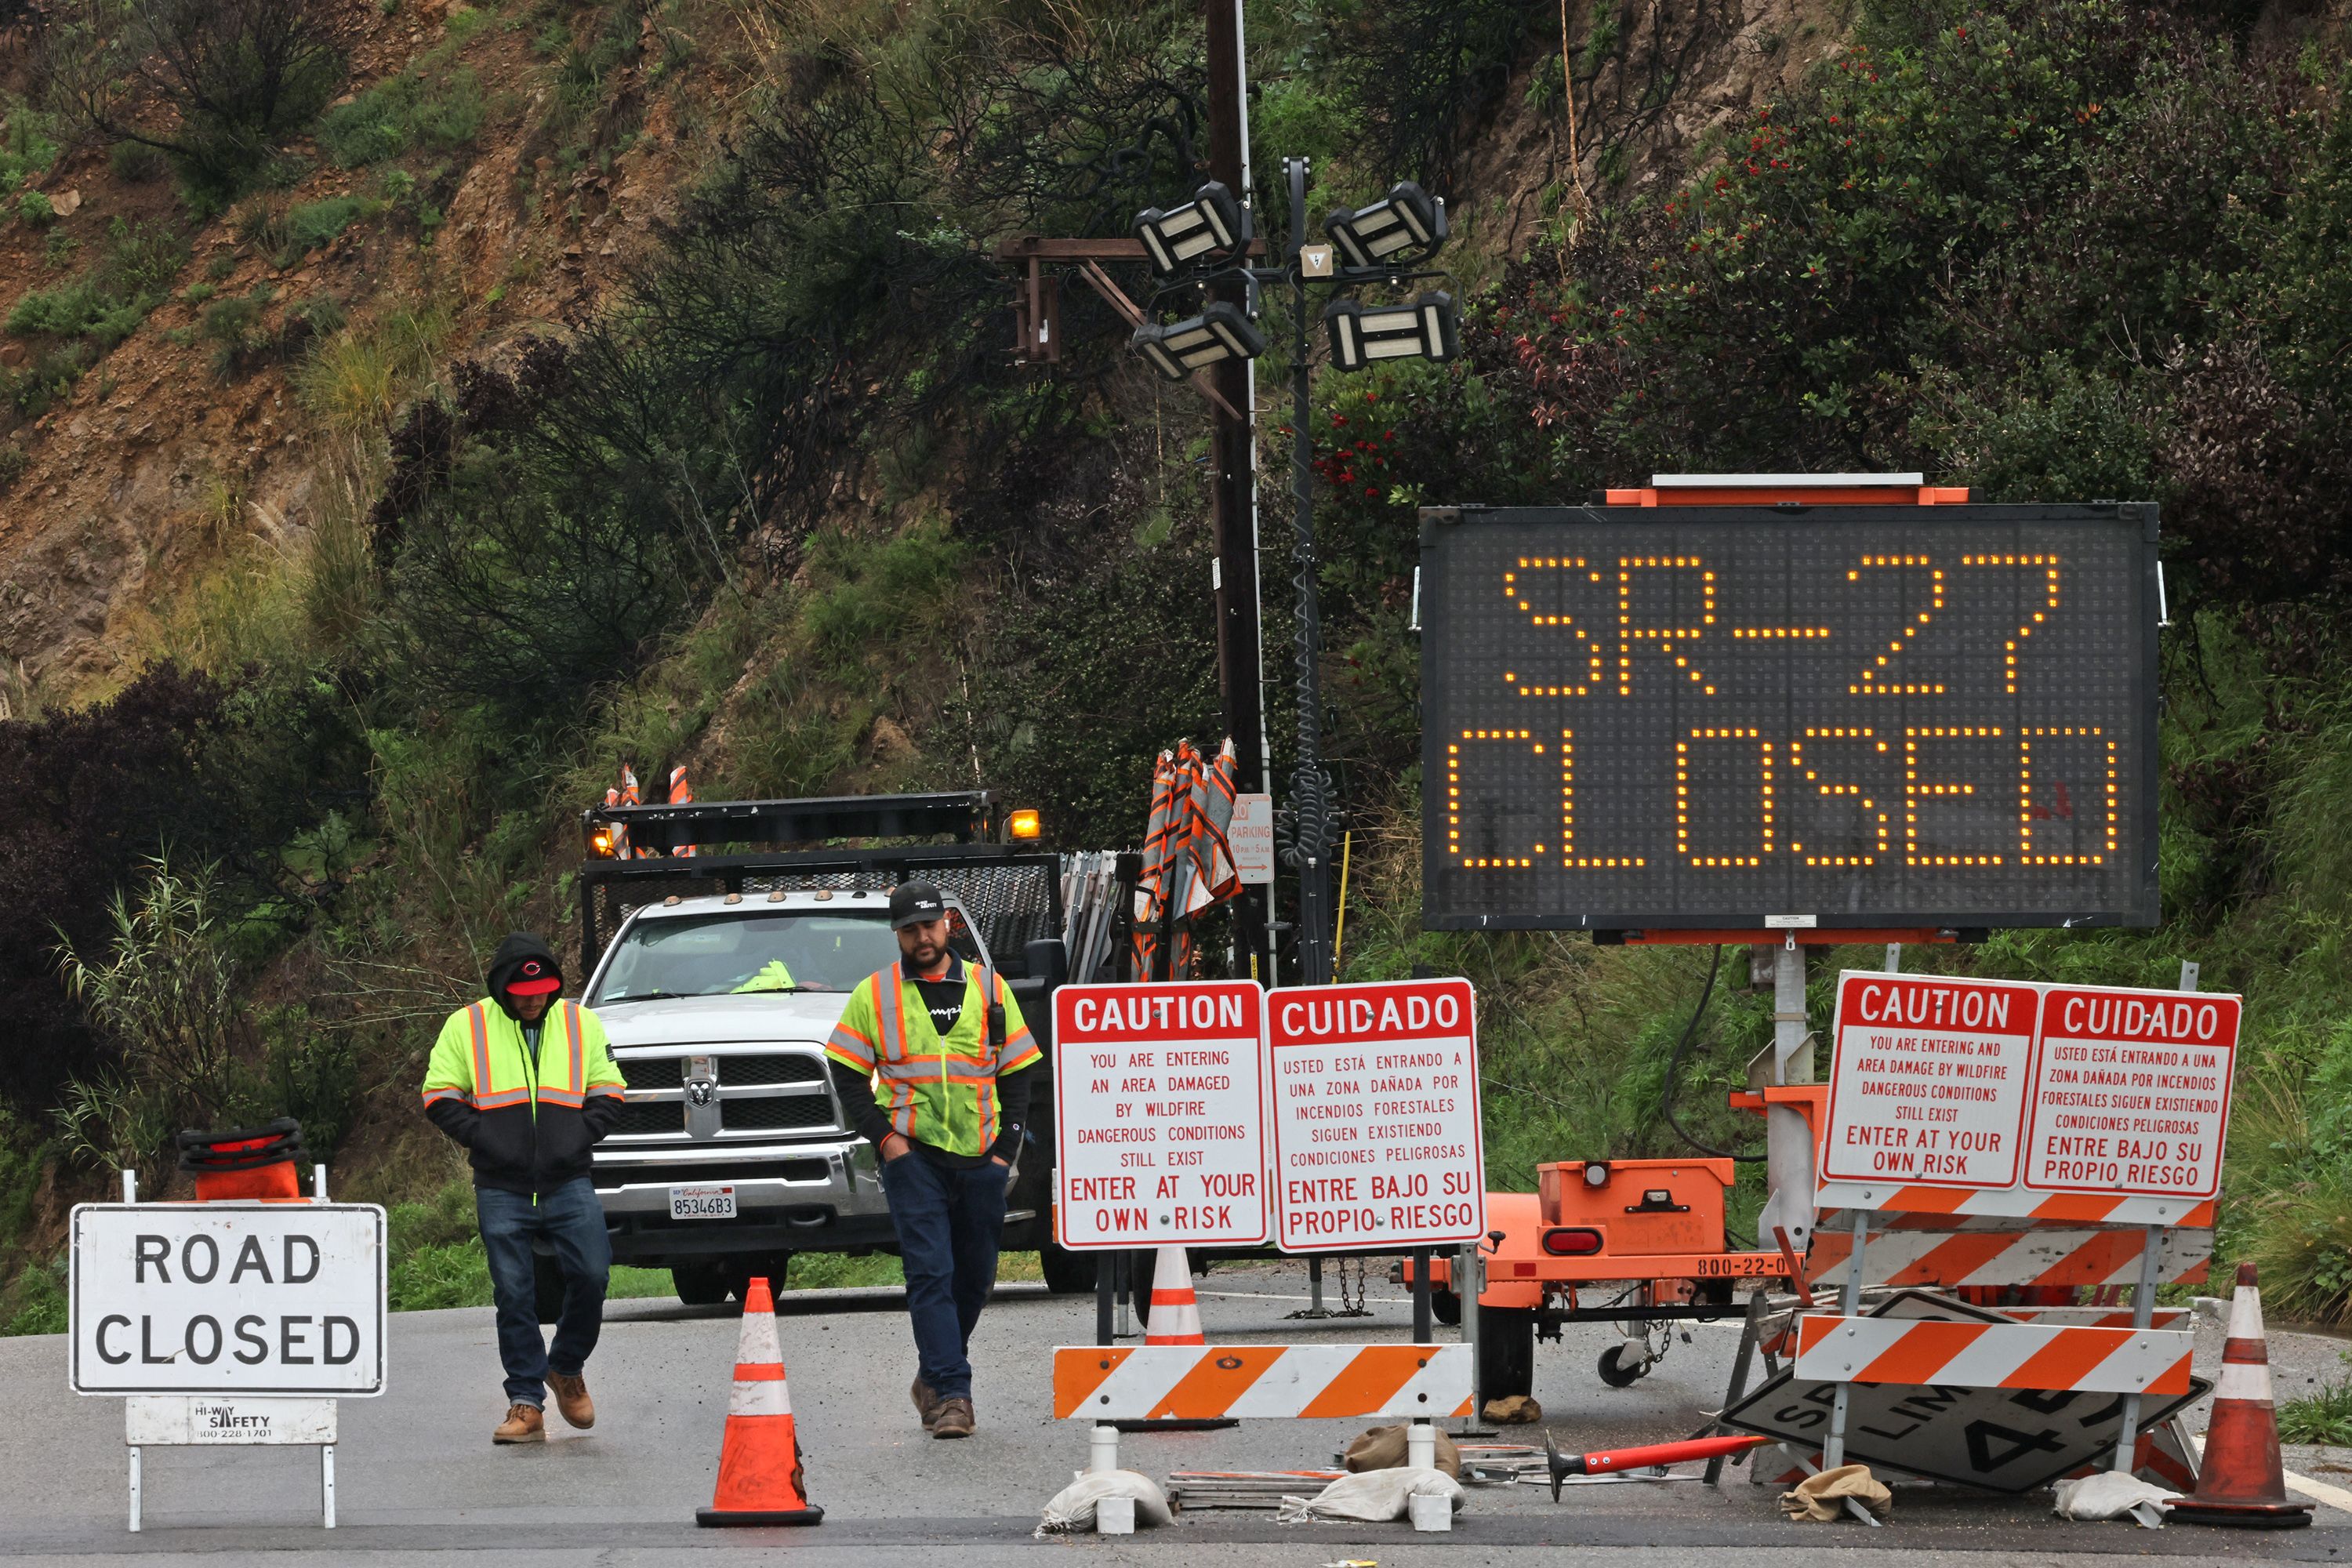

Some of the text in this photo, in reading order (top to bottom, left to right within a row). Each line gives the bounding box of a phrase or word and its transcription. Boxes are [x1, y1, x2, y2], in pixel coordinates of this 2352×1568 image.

[1505, 555, 2057, 695] SR-27
[1448, 728, 2116, 867] CLOSED
[1231, 826, 1270, 839] PARKING
[1256, 844, 1260, 853] 5
[1075, 995, 1242, 1031] CAUTION
[1283, 995, 1458, 1036] CUIDADO
[1861, 985, 2009, 1027] CAUTION
[2065, 998, 2216, 1039] CUIDADO
[1871, 1035, 2001, 1057] YOU ARE ENTERING AND
[2054, 1047, 2216, 1067] USTED ESTÁ ENTRANDO A UNA
[1091, 1051, 1229, 1069] YOU ARE ENTERING
[1285, 1052, 1461, 1074] USTED ESTÁ ENTRANDO A
[1857, 1058, 2007, 1080] AREA DAMAGE BY WILDFIRE
[1092, 1076, 1229, 1092] AN AREA DAMAGED
[1290, 1075, 1457, 1097] UNA ZONA DAÑADA POR
[2049, 1067, 2218, 1091] ZONA DAÑADA POR INCENDIOS
[1861, 1081, 1998, 1102] DANGEROUS CONDITIONS
[2042, 1091, 2219, 1114] FORESTALES SIGUEN EXISTIENDO
[1116, 1101, 1204, 1117] BY WILDFIRE
[1297, 1098, 1454, 1120] INCENDIOS FORESTALES
[1896, 1105, 1957, 1122] STILL EXIST
[1079, 1124, 1245, 1144] DANGEROUS CONDITIONS
[1312, 1123, 1442, 1142] SIGUEN EXISTIENDO
[2056, 1114, 2199, 1135] CONDICIONES PELIGROSAS
[1846, 1124, 2002, 1152] ENTER AT YOUR
[2047, 1135, 2202, 1163] ENTRE BAJO SU
[1121, 1151, 1203, 1167] STILL EXIST
[1291, 1145, 1465, 1167] CONDICIONES PELIGROSAS
[1874, 1151, 1968, 1174] OWN RISK
[2045, 1160, 2198, 1187] PROPIO RIESGO
[1071, 1173, 1254, 1201] ENTER AT YOUR
[1289, 1171, 1471, 1204] ENTRE BAJO SU
[675, 1198, 731, 1214] 85346B3
[1096, 1205, 1232, 1232] OWN RISK
[1290, 1203, 1473, 1236] PROPIO RIESGO
[136, 1235, 319, 1283] ROAD
[96, 1315, 359, 1364] CLOSED
